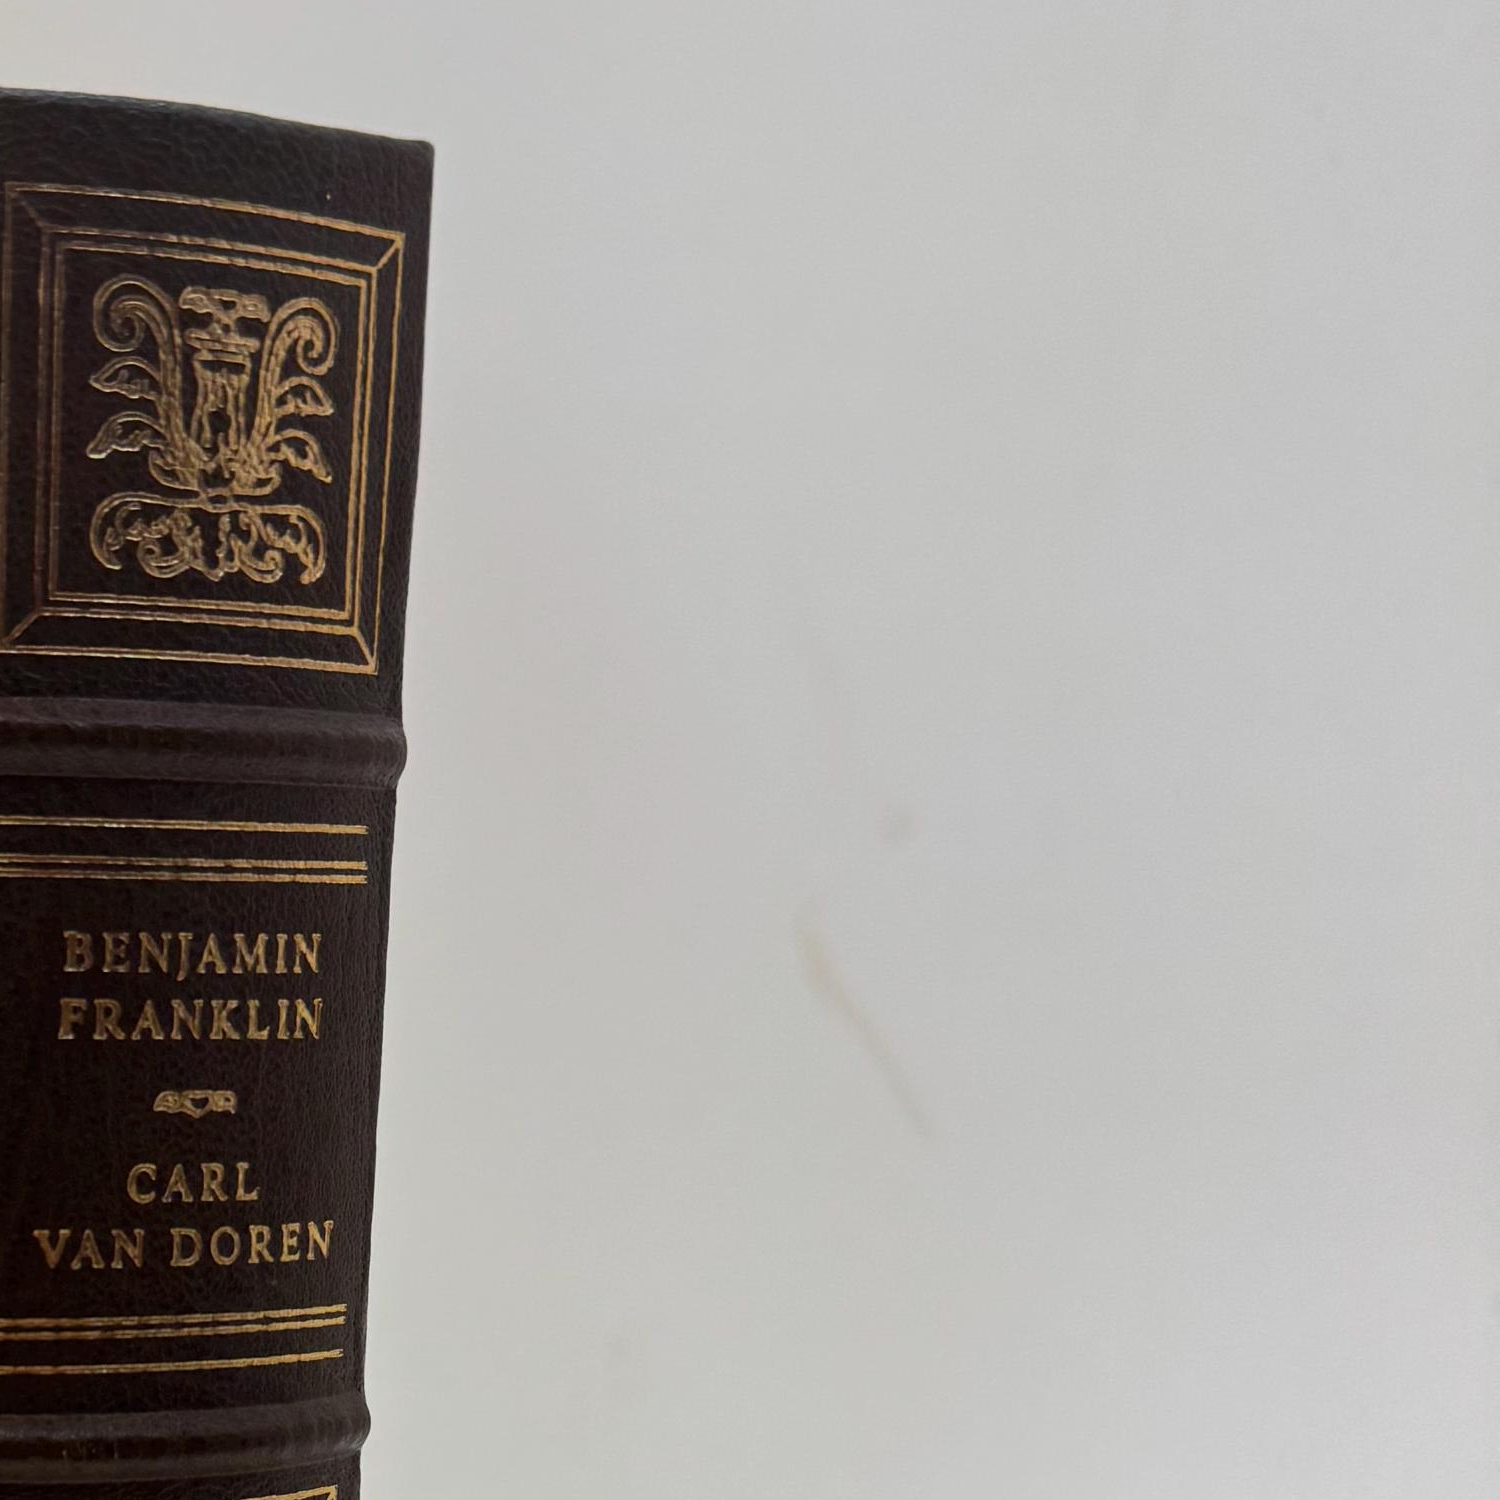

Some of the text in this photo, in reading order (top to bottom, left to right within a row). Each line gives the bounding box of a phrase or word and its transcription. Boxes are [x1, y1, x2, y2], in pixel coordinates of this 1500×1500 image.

[62, 930, 322, 981] BENJAMIN
[57, 998, 323, 1040] FRANKLIN
[127, 1162, 260, 1203] CARL
[33, 1220, 334, 1269] VAN DOREN
